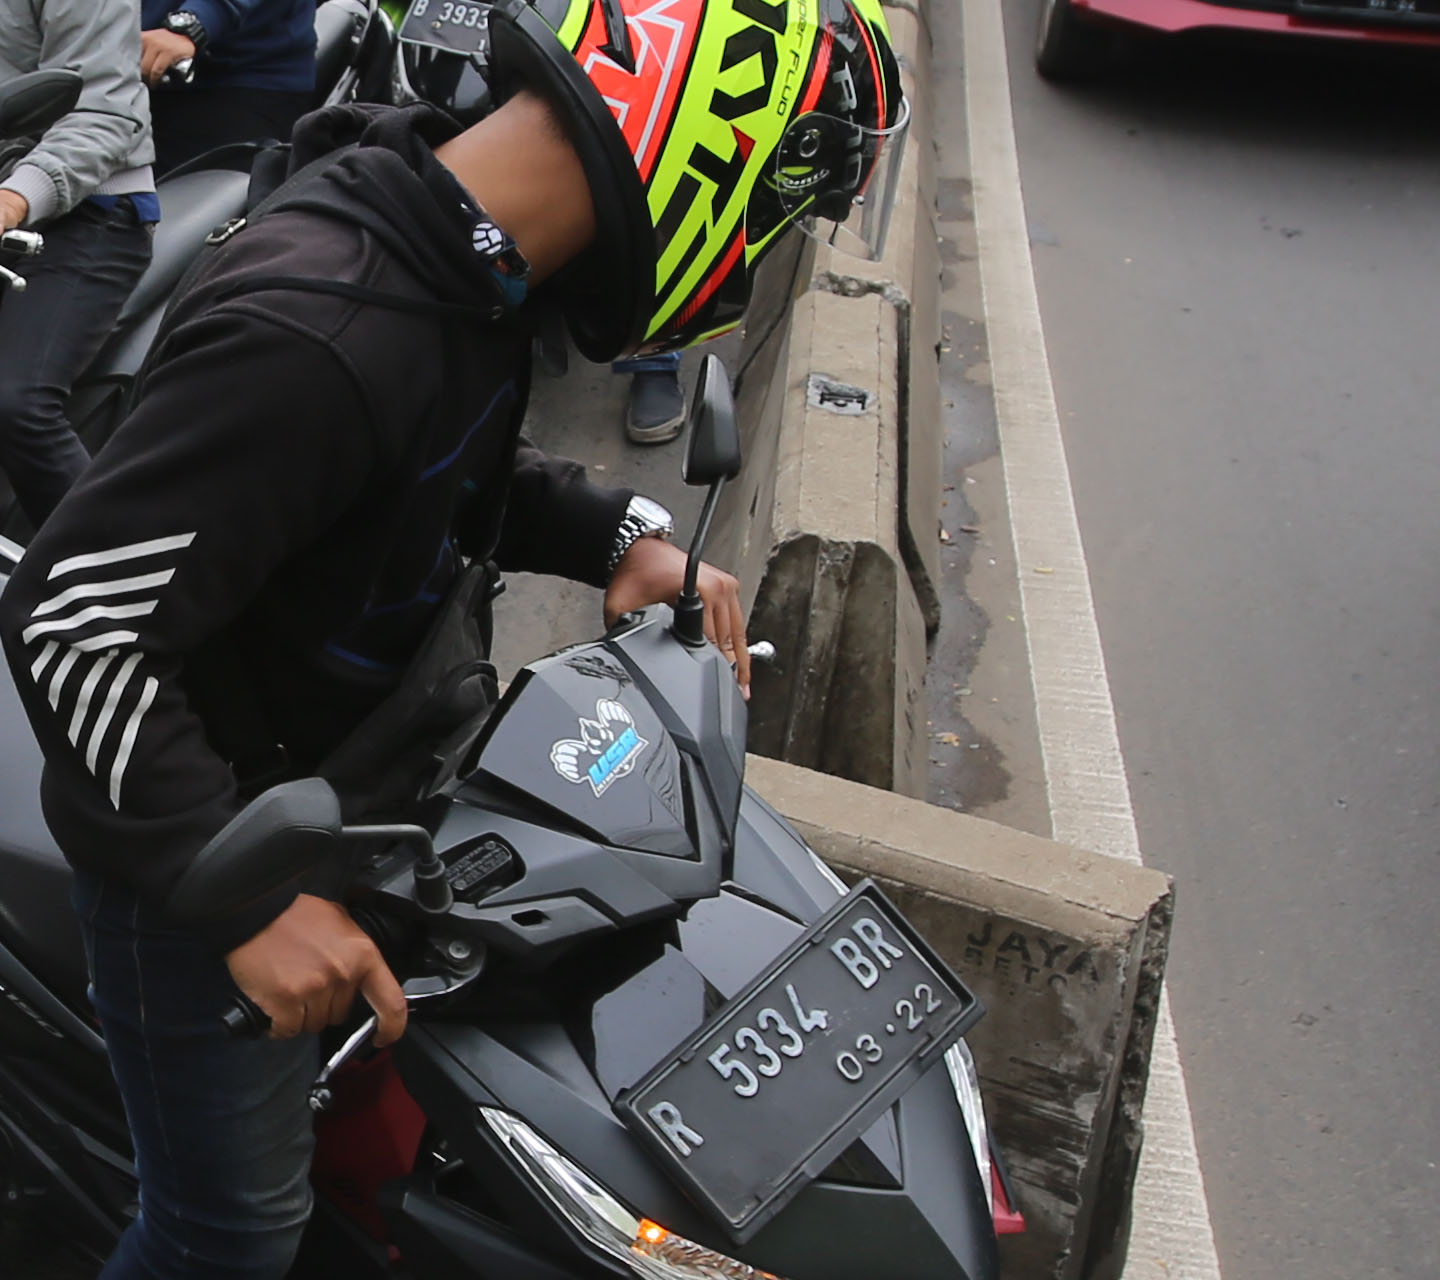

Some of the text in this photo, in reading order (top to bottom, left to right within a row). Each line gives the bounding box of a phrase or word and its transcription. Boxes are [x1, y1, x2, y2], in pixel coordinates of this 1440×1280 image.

[438, 1, 490, 30] 3933
[967, 922, 1100, 983] JAYA
[648, 917, 905, 1157] R 5334 BR
